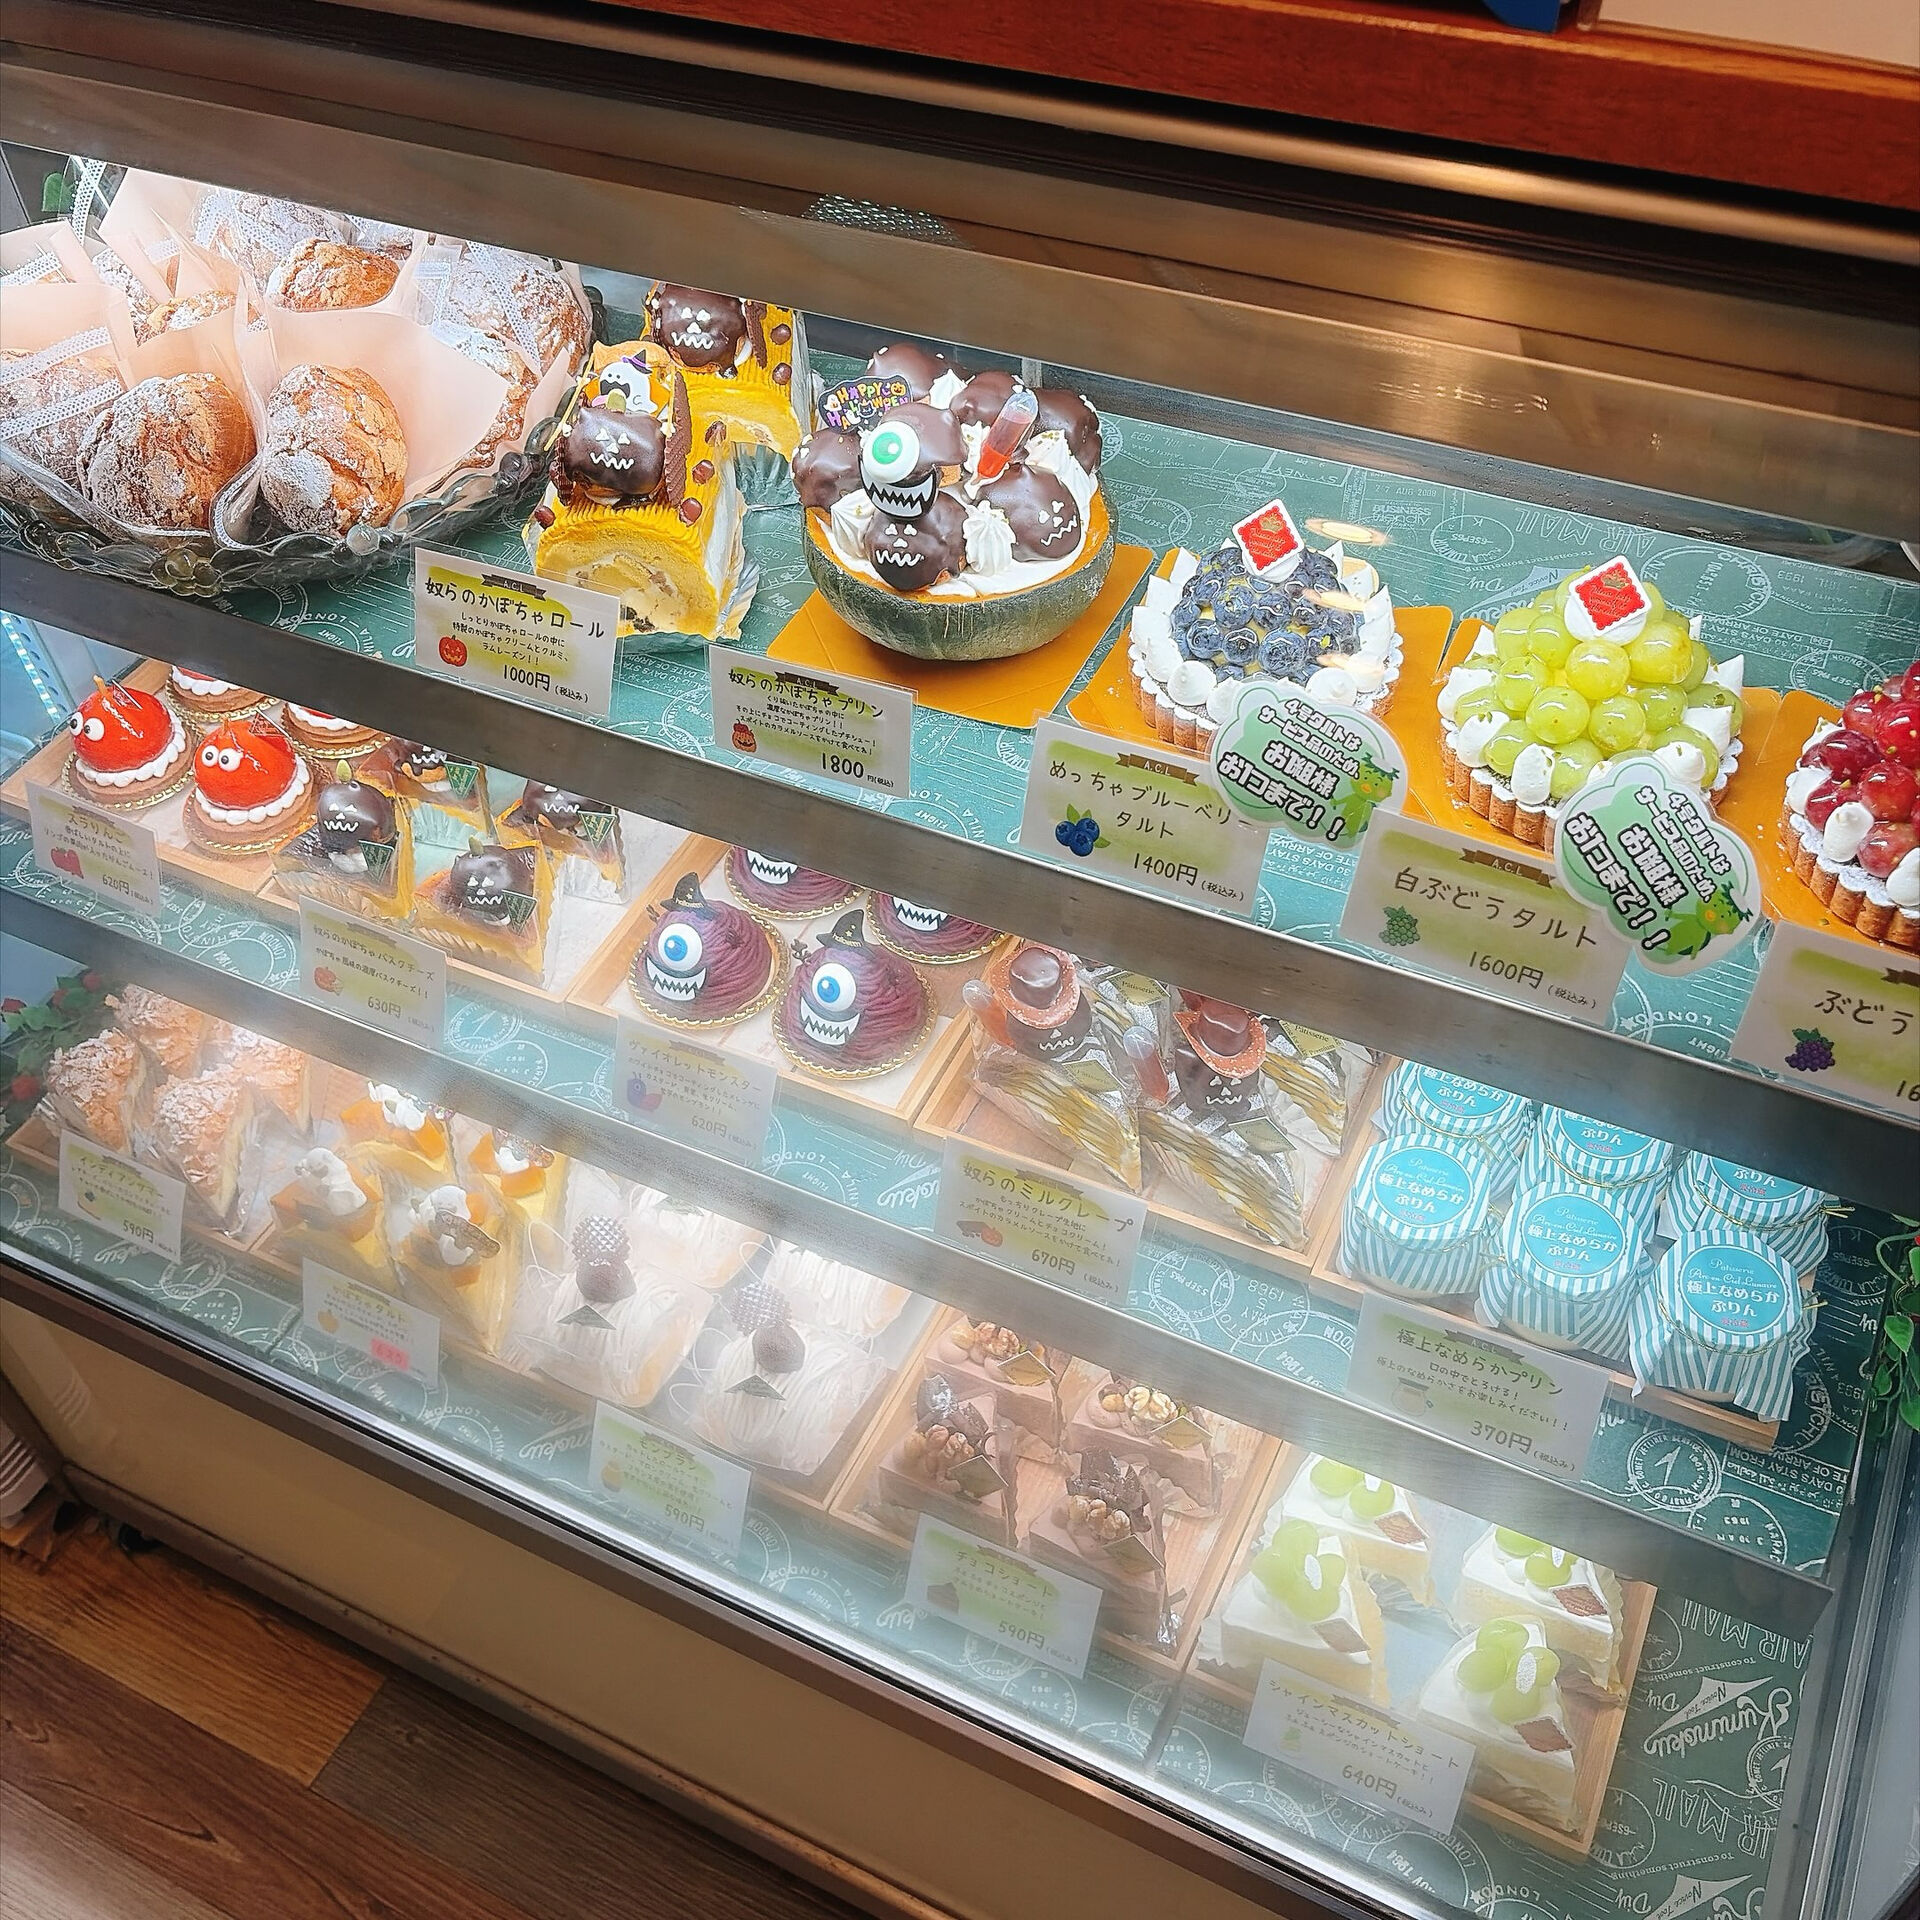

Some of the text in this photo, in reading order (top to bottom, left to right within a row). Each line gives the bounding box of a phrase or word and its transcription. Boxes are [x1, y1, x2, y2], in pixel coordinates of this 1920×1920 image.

[836, 382, 883, 403] HAPPY
[1514, 507, 1592, 546] MAIL
[425, 577, 604, 639] 奴らのかぼちゃロール
[462, 613, 565, 648] しっとりかぼちゃロールの中に
[504, 664, 551, 692] 1000円
[728, 668, 884, 718] 奴らのかぼちゃプリン
[1284, 698, 1363, 751] 4号タルトは
[1258, 705, 1362, 780] サービス品のため、
[821, 752, 864, 778] 1800
[1261, 740, 1342, 799] お1組様
[1049, 760, 1253, 827] めっちゃブルーベリー
[68, 812, 123, 844] スラりんご
[1116, 810, 1175, 839] タルト
[1668, 791, 1733, 876] 4号タルトは
[1633, 785, 1717, 904] サービス品のため、
[1132, 852, 1199, 886] 1400円
[1620, 824, 1689, 907] お1組様
[1394, 867, 1598, 951] 白ぶどうタルト
[313, 924, 435, 982] 奴らのかぼちゃバスクチーズ
[1468, 950, 1544, 990] 1600円
[367, 996, 401, 1018] 630円
[1815, 989, 1914, 1035] ぶどう
[629, 1040, 761, 1092] ヴァイオレットモンスター
[1437, 1087, 1478, 1108] ぷりん
[691, 1115, 727, 1138] 620円
[1581, 1128, 1623, 1146] ぷりん
[1379, 1173, 1464, 1205] 極上なめらか
[1733, 1167, 1778, 1188] ぷりん
[963, 1162, 1134, 1232] 奴らのミルクレープ
[1395, 1194, 1435, 1213] ぷりん
[1527, 1223, 1617, 1253] 極上なめらか
[1546, 1244, 1591, 1262] ぷりん
[1032, 1249, 1075, 1276] 670円
[1685, 1280, 1781, 1304] 極上なめらか
[1711, 1299, 1757, 1317] ぷりん
[1397, 1328, 1563, 1395] 極上なめらかプリン
[1471, 1420, 1533, 1455] 370円
[665, 1504, 704, 1531] 590円
[956, 1551, 1053, 1598] チョコショート
[999, 1621, 1044, 1650] 590円
[1269, 1679, 1459, 1769] シャインマスカットショート
[1342, 1764, 1398, 1800] 640円
